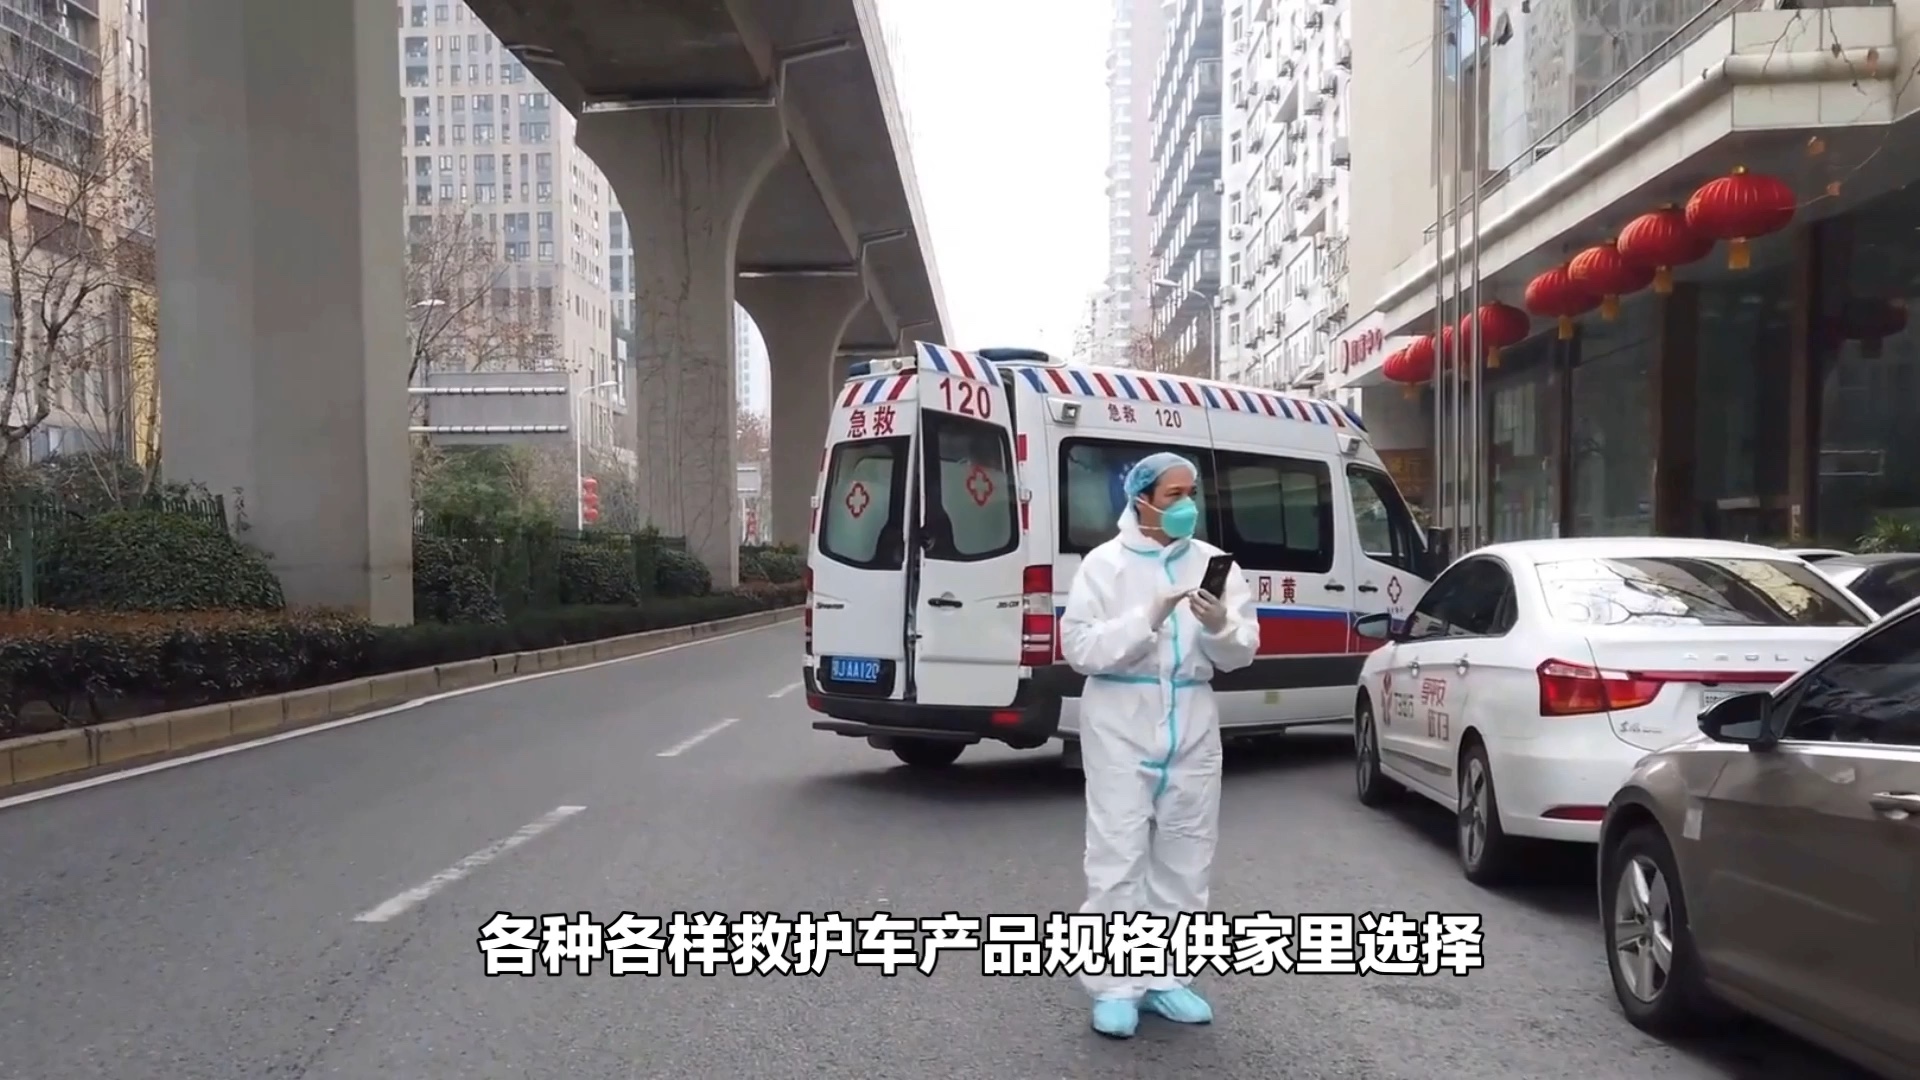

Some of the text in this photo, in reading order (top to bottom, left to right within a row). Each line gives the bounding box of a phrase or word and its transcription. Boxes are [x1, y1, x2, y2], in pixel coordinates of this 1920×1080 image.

[939, 377, 992, 419] 120
[847, 406, 896, 438] 急救
[1108, 403, 1182, 428] 急救 120
